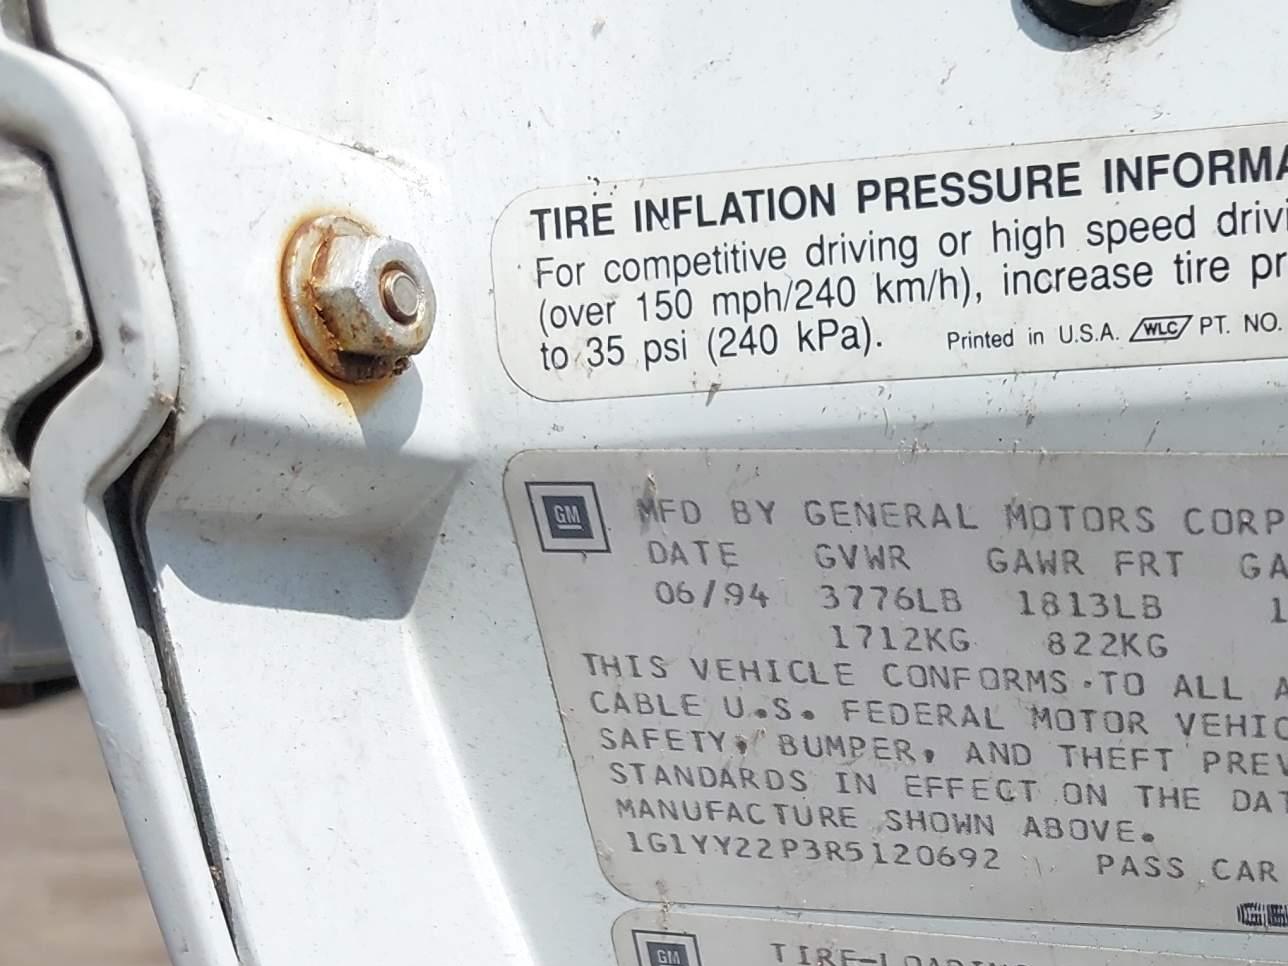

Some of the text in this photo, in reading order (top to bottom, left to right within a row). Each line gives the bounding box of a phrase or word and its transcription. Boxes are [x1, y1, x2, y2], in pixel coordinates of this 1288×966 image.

[530, 203, 614, 240] TIRE
[635, 188, 835, 232] INFLATION
[858, 162, 1082, 213] PRESSURE
[537, 257, 585, 288] For
[605, 241, 786, 286] competitive
[806, 230, 917, 268] driving
[939, 231, 971, 257] or
[993, 216, 1064, 259] high
[1086, 209, 1196, 252] speed
[539, 295, 616, 331] (over
[637, 289, 692, 321] 150
[713, 276, 855, 323] mph/240
[876, 267, 981, 307] km/h),
[1004, 262, 1152, 295] increase
[1174, 250, 1229, 285] tire
[541, 316, 881, 371] to 35 psi (240 kPa).
[948, 329, 1013, 349] Printed
[1028, 326, 1044, 346] in
[1059, 324, 1120, 344] U.S.A.
[1143, 322, 1178, 336] WLC
[1199, 316, 1230, 335] PT.
[1244, 313, 1283, 333] NO.
[554, 505, 580, 524] GM
[638, 499, 1284, 535] MFD BY GENERAL MOTORS CORP
[648, 540, 738, 568] DATE
[815, 544, 910, 570] GVWR
[987, 548, 1084, 576] GAWR
[1116, 551, 1183, 577] FRT
[656, 580, 769, 608] 06/94
[821, 585, 962, 613] 3776LB
[1019, 590, 1162, 619] 1813LB
[832, 625, 969, 652] 1712KG
[1048, 632, 1168, 658] 822KG
[582, 653, 667, 678] THIS
[690, 658, 854, 686] VEHICLE
[883, 663, 1067, 694] CONFORMS
[1099, 671, 1144, 696] TO
[1174, 674, 1242, 700] ALL
[590, 691, 702, 716] CABLE
[724, 696, 814, 720] U.S.
[842, 700, 1004, 730] FEDERAL
[1031, 704, 1148, 735] MOTOR
[600, 728, 747, 755] SAFETY,
[778, 734, 934, 765] BUMPER,
[966, 741, 1031, 766] AND
[1058, 745, 1173, 771] THEFT
[610, 762, 807, 792] STANDARDS
[836, 772, 876, 795] IN
[905, 775, 1037, 802] EFFECT
[1063, 783, 1107, 806] ON
[1134, 785, 1200, 810] THE
[616, 799, 1154, 842] MANUFACTURE SHOWN ABOVE.
[627, 832, 1278, 882] 1G1YY22P3R5120692 PASS CAR
[657, 949, 680, 965] GM
